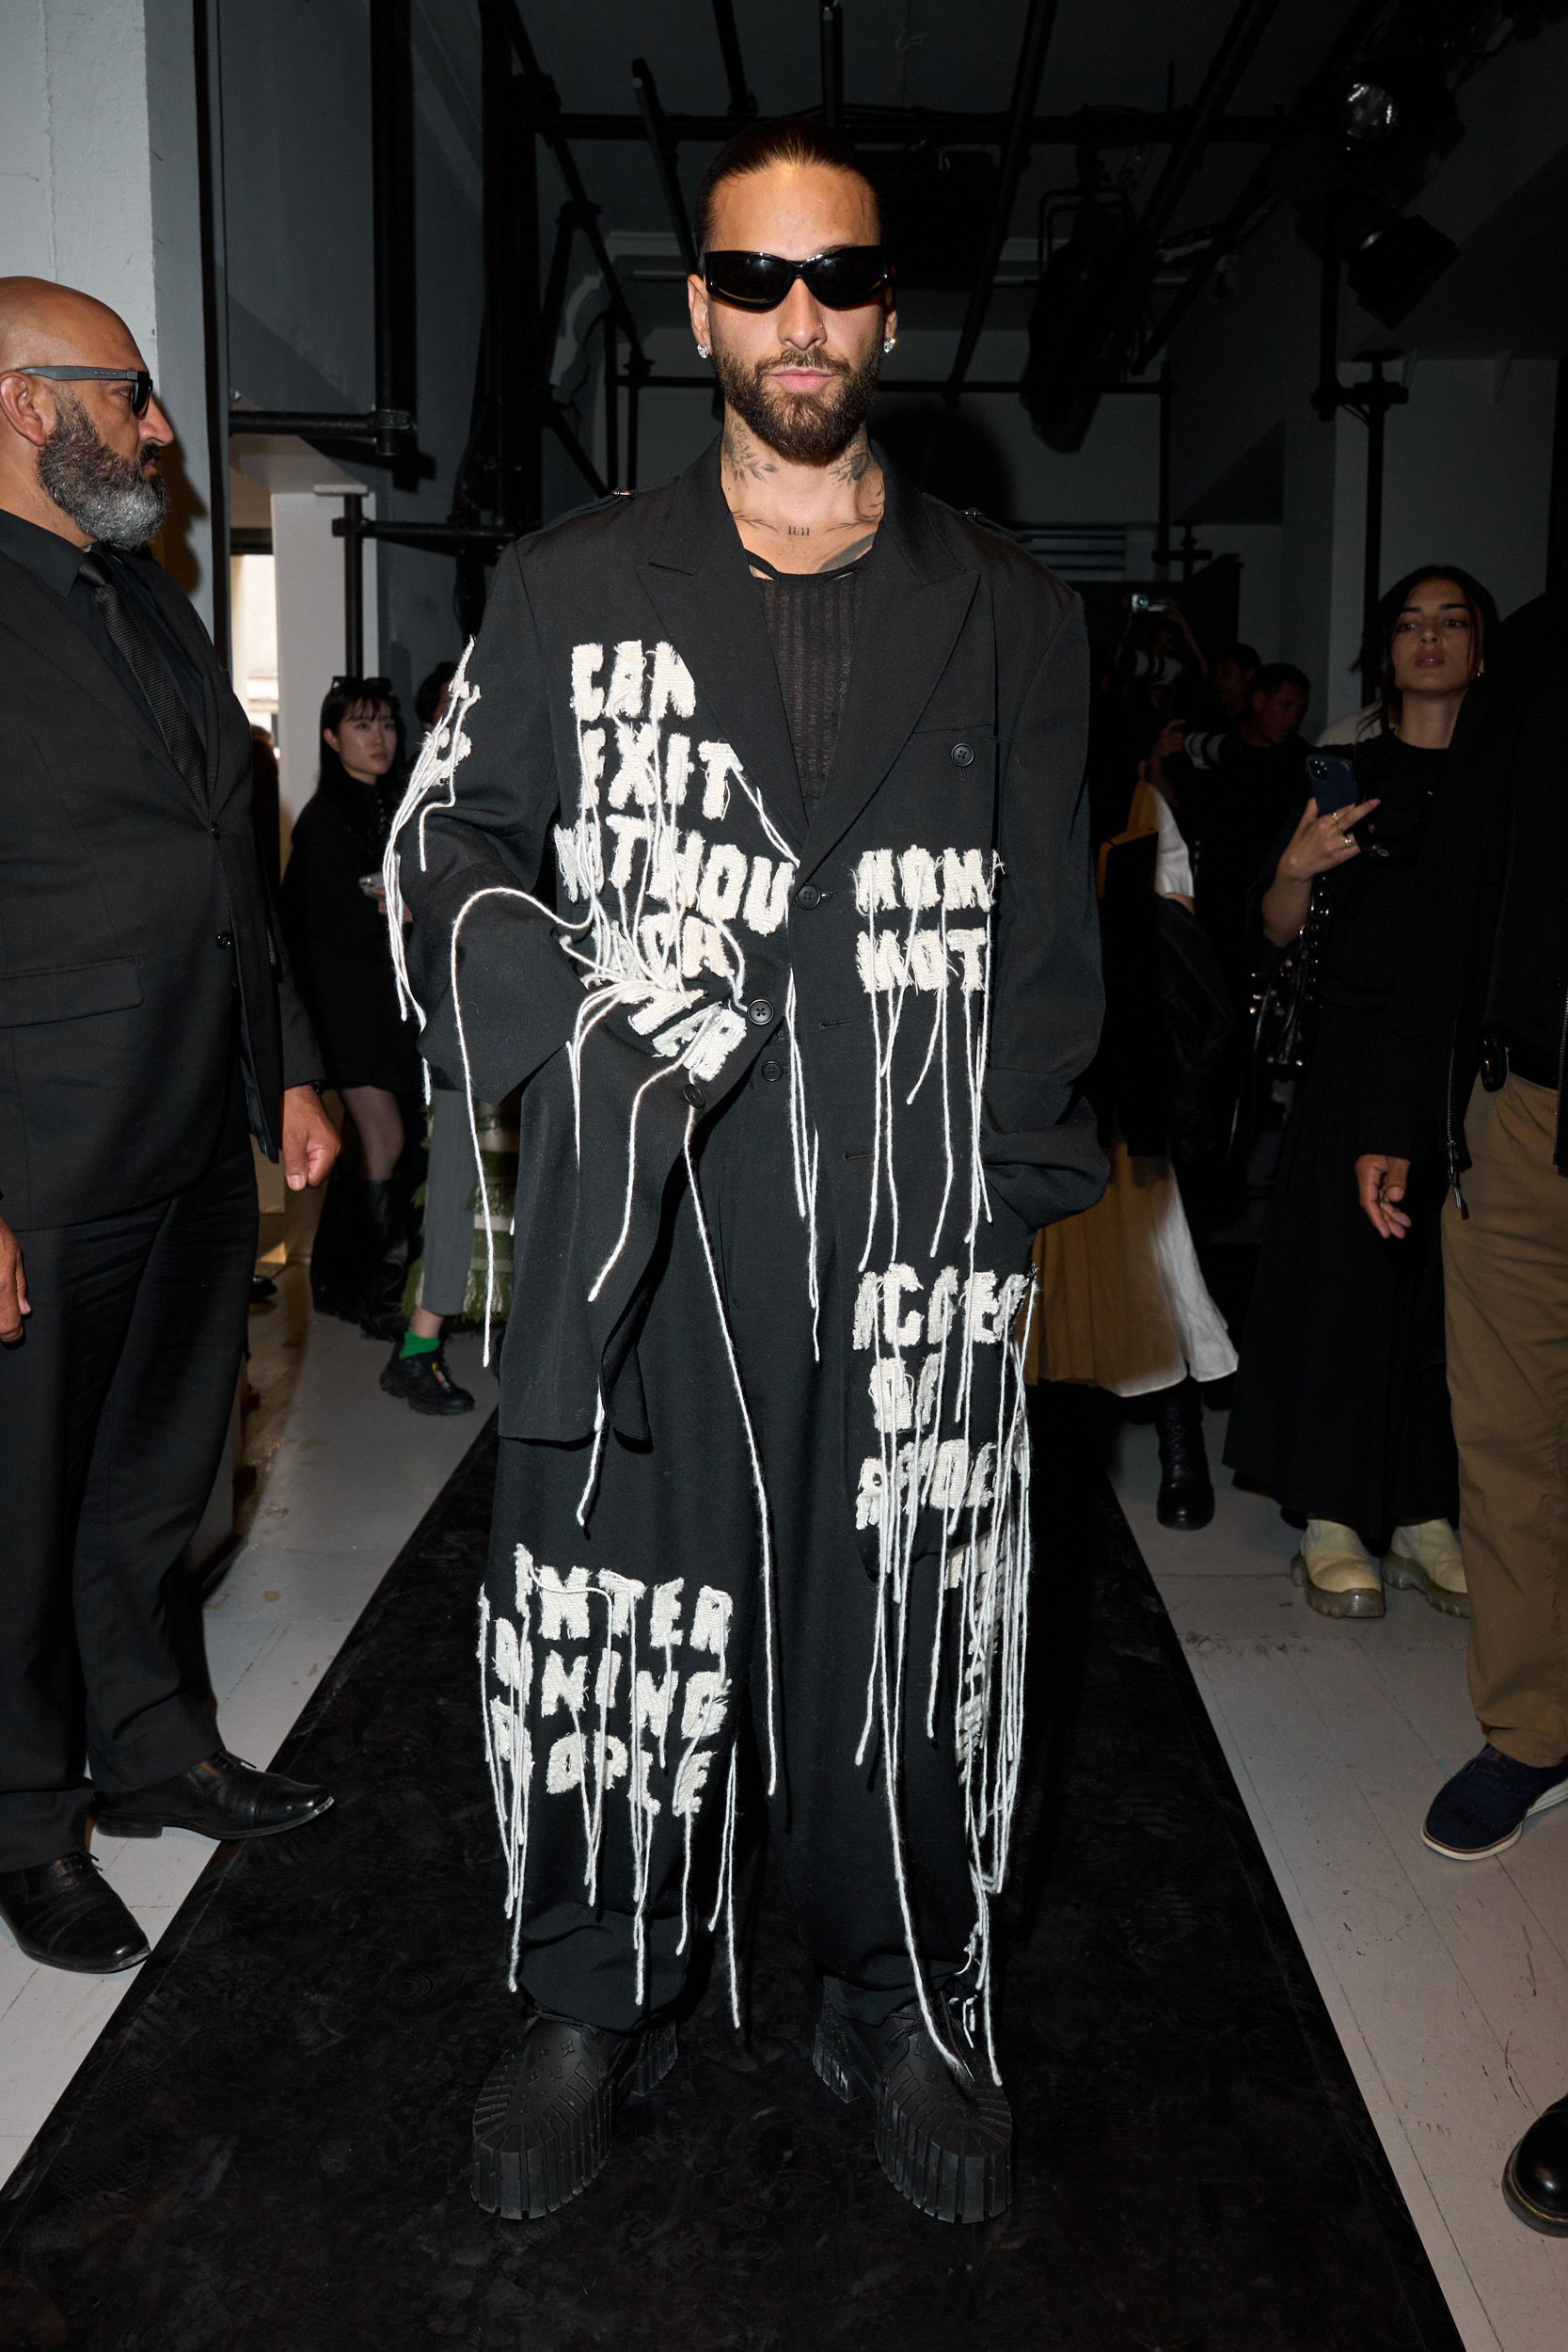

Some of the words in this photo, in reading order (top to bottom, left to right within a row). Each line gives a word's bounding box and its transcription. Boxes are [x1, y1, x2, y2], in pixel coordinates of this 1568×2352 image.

[788, 526, 810, 536] 11:11
[570, 640, 696, 722] CAN
[580, 723, 742, 820] EXIT
